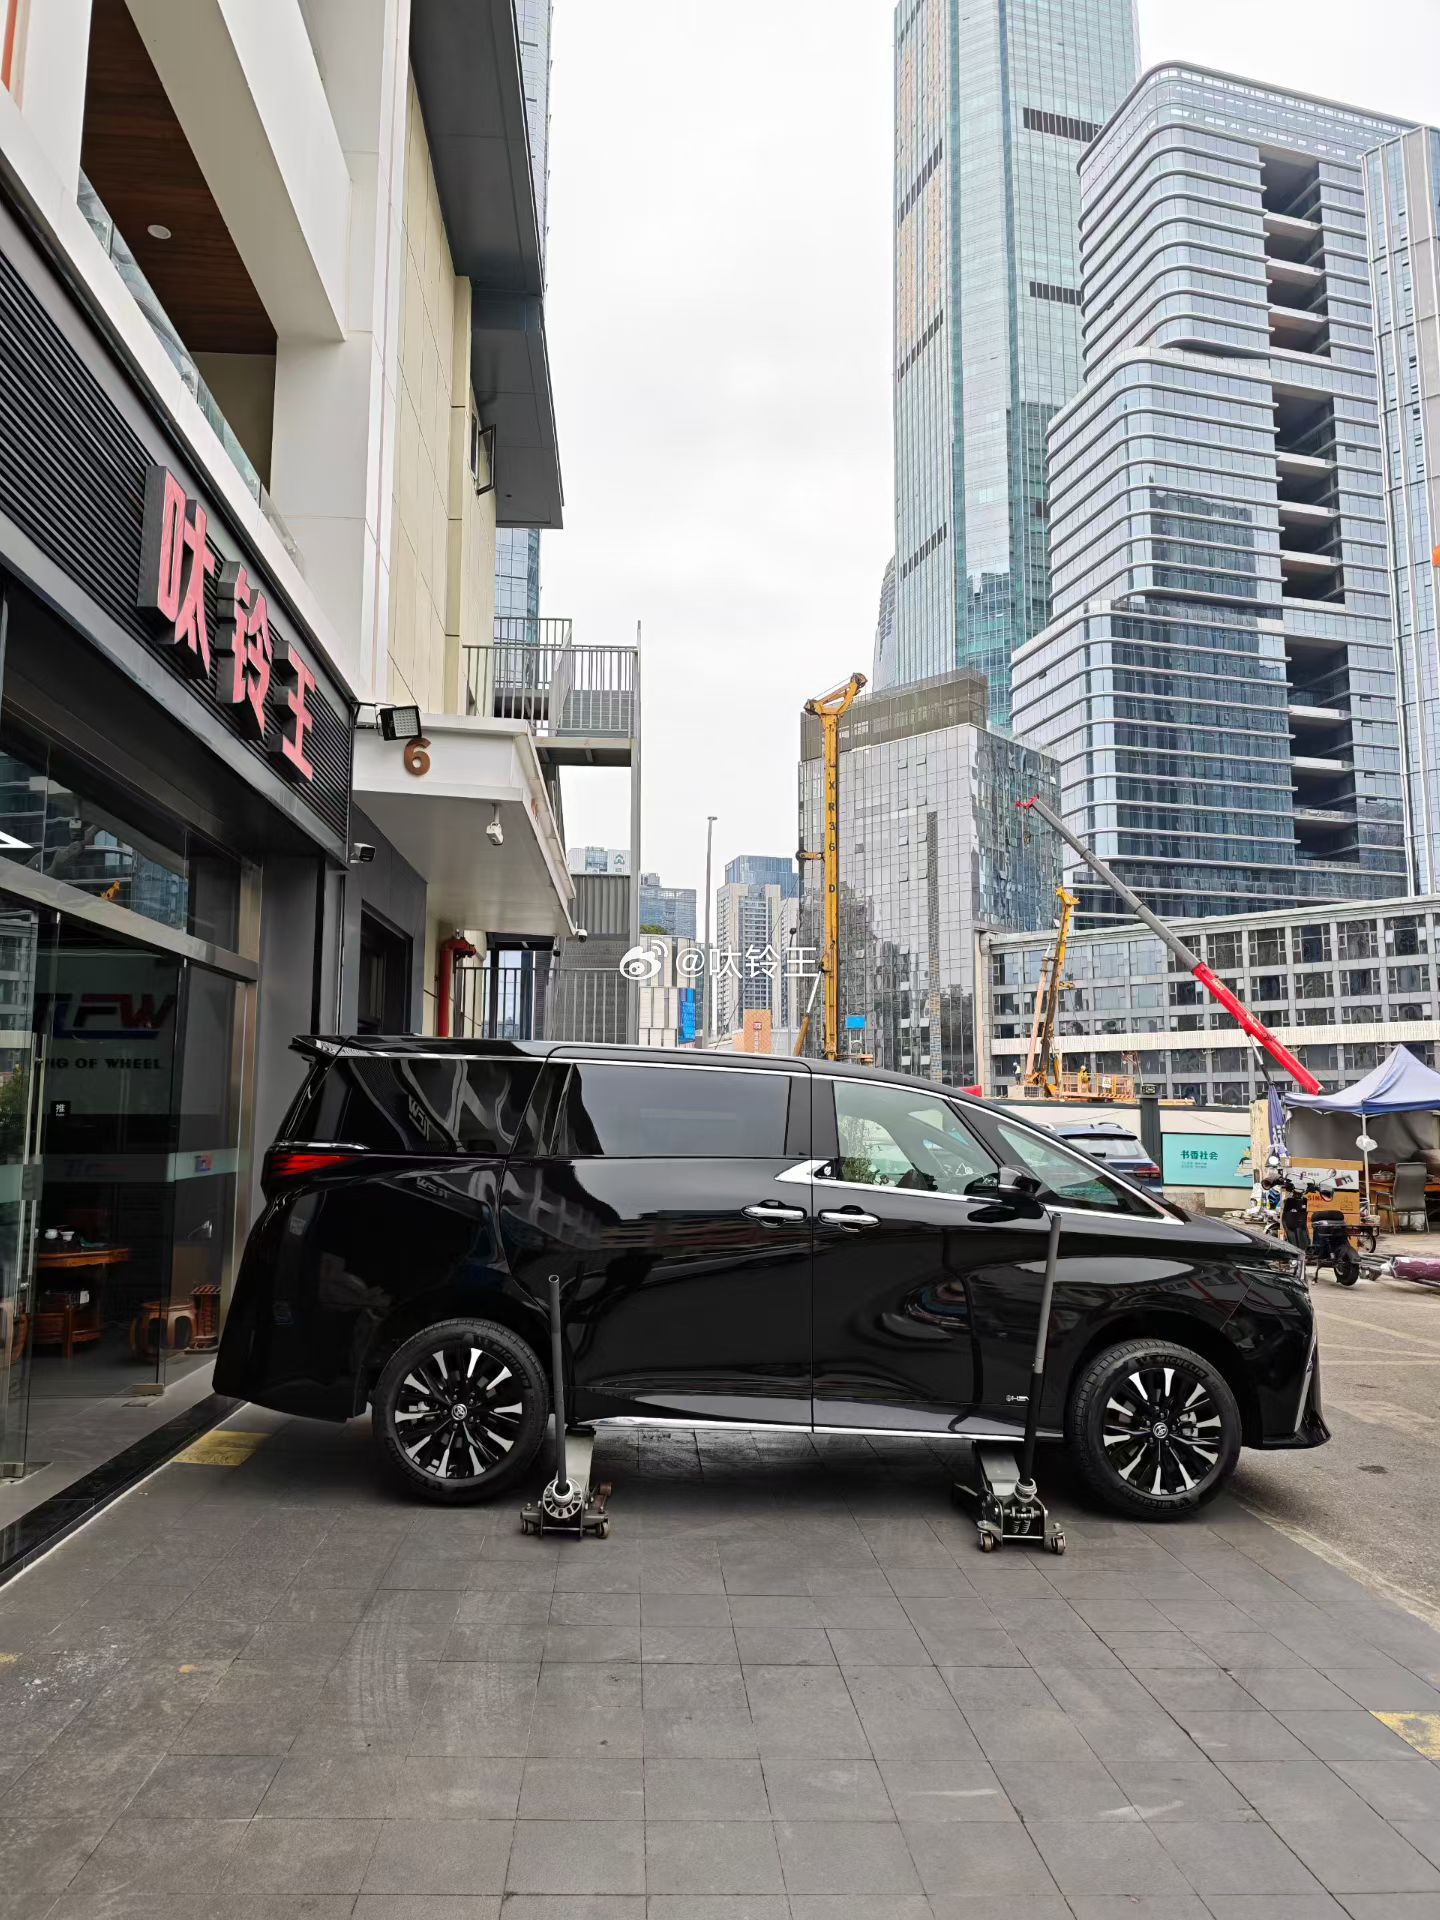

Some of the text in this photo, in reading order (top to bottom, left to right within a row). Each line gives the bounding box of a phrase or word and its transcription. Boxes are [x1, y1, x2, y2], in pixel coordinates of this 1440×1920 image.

[404, 737, 431, 776] 6
[75, 1058, 98, 1069] OF
[105, 1058, 162, 1069] WHEEL
[1180, 1150, 1219, 1160] 书香社会
